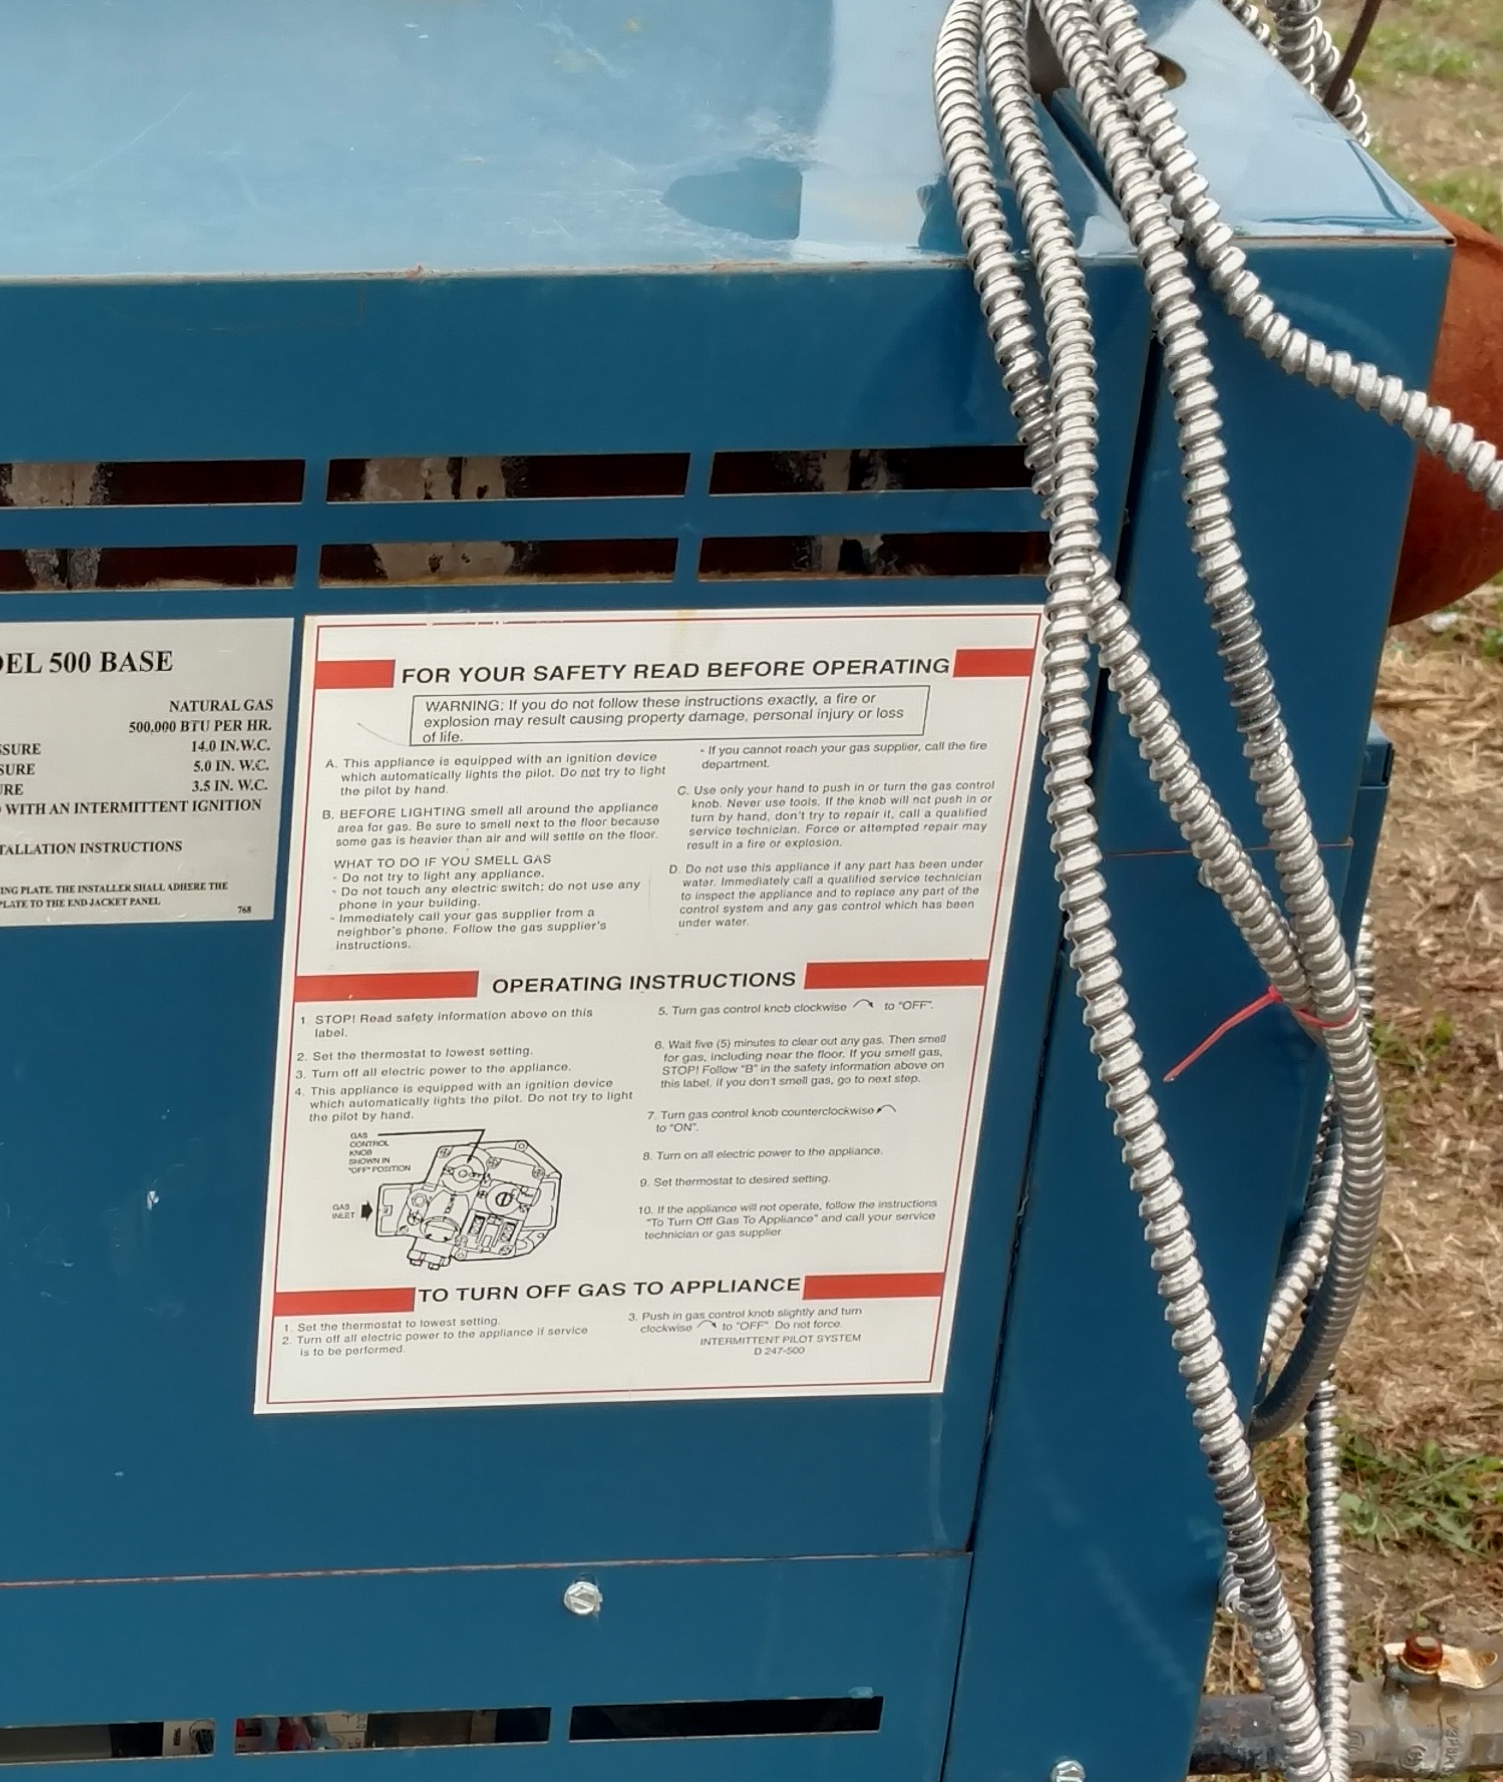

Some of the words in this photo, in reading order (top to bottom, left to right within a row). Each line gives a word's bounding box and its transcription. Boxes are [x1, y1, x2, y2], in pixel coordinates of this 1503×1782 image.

[49, 652, 91, 673] 500
[100, 651, 173, 672] BASE
[402, 668, 450, 683] FOR
[459, 666, 525, 682] YOUR
[533, 664, 627, 681] SAFETY
[634, 663, 699, 679] READ
[707, 661, 805, 677] BEFORE
[813, 658, 949, 676] OPERATING
[169, 699, 240, 712] NATURAL
[243, 699, 273, 711] GAS
[426, 699, 504, 712] WARNING:
[509, 699, 517, 710] If
[521, 701, 546, 713] you
[551, 699, 568, 710] do
[572, 699, 594, 709] not
[599, 697, 639, 709] follow
[643, 697, 680, 708] these
[684, 695, 763, 707] instructions
[767, 694, 818, 707] exactly,
[823, 695, 832, 704] a
[836, 693, 858, 704] fire
[862, 695, 876, 704] or
[424, 715, 489, 730] explosion
[494, 717, 524, 729] may
[528, 714, 566, 725] result
[570, 715, 623, 727] causing
[627, 712, 685, 726] property
[688, 711, 748, 724] damage,
[753, 708, 813, 723] personal
[817, 708, 855, 722] injury
[858, 710, 873, 719] or
[876, 707, 904, 719] loss
[129, 721, 176, 733] 500,000
[180, 720, 210, 732] BTU
[214, 720, 242, 731] PER
[247, 719, 272, 731] HR.
[422, 731, 436, 743] of
[440, 731, 463, 743] life.
[192, 740, 216, 752] 14.0
[193, 760, 212, 772] 5.0
[216, 760, 235, 772] IN.
[239, 759, 269, 771] W.C.
[192, 780, 210, 792] 3.5
[214, 779, 233, 791] IN.
[238, 779, 268, 791] W.C.
[5, 803, 46, 815] WITH
[49, 803, 69, 815] AN
[74, 800, 189, 814] INTERMITTENT
[192, 799, 261, 812] IGNITION
[80, 841, 182, 854] INSTRUCTIONS
[334, 858, 373, 869] WHAT
[377, 858, 395, 868] TO
[400, 857, 420, 868] DO
[425, 857, 437, 867] IF
[441, 856, 470, 866] YOU
[474, 855, 519, 866] SMELL
[523, 854, 551, 865] GAS
[56, 885, 75, 894] THE
[78, 884, 131, 893] INSTALLER
[133, 883, 165, 892] SHALL
[168, 882, 206, 891] ADHERE
[208, 882, 228, 891] THE
[30, 899, 44, 908] TO
[46, 899, 65, 908] THE
[68, 898, 88, 907] END
[89, 898, 128, 907] JACKET
[129, 897, 161, 906] PANEL
[238, 906, 252, 914] 768
[493, 976, 621, 993] OPERATING
[630, 972, 795, 990] INSTRUCTIONS
[315, 1014, 355, 1025] STOP!
[360, 1013, 392, 1023] Read
[396, 1012, 434, 1024] safety
[438, 1011, 506, 1021] information
[510, 1010, 548, 1019] above
[551, 1010, 567, 1018] on
[571, 1008, 593, 1017] this
[315, 1028, 348, 1038] label.
[418, 1288, 448, 1302] TO
[456, 1286, 518, 1301] TURN
[526, 1284, 571, 1299] OFF
[578, 1282, 626, 1297] GAS
[633, 1281, 663, 1295] TO
[670, 1278, 801, 1294] APPLIANCE
[700, 1336, 780, 1346] INTERMITTENT
[782, 1335, 813, 1343] PILOT
[817, 1334, 861, 1343] SYSTEM
